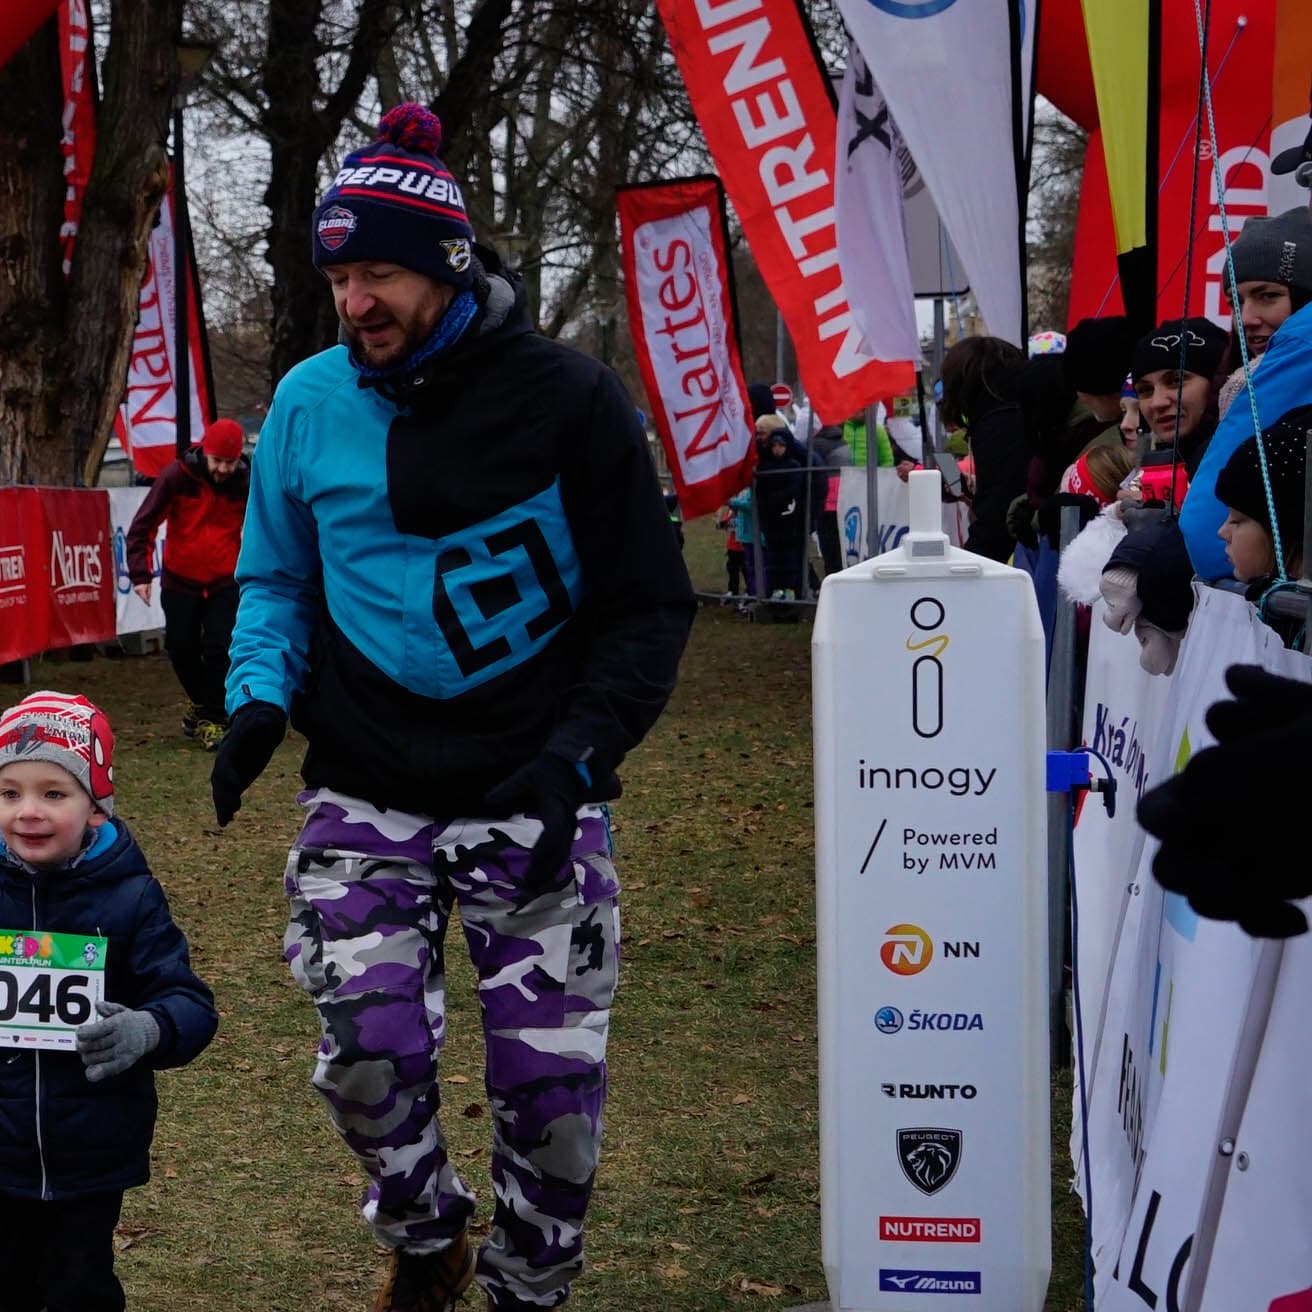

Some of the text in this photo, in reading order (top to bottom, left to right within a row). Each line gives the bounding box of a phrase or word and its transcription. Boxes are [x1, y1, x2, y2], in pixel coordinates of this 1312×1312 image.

[653, 238, 730, 462] Nartes
[859, 759, 997, 796] innogy
[903, 827, 998, 845] Powered
[903, 852, 997, 874] by MVM
[943, 941, 980, 958] NN
[907, 1009, 984, 1031] ŠKODA
[899, 1084, 977, 1099] RUNTO
[885, 1222, 976, 1238] NUTREND
